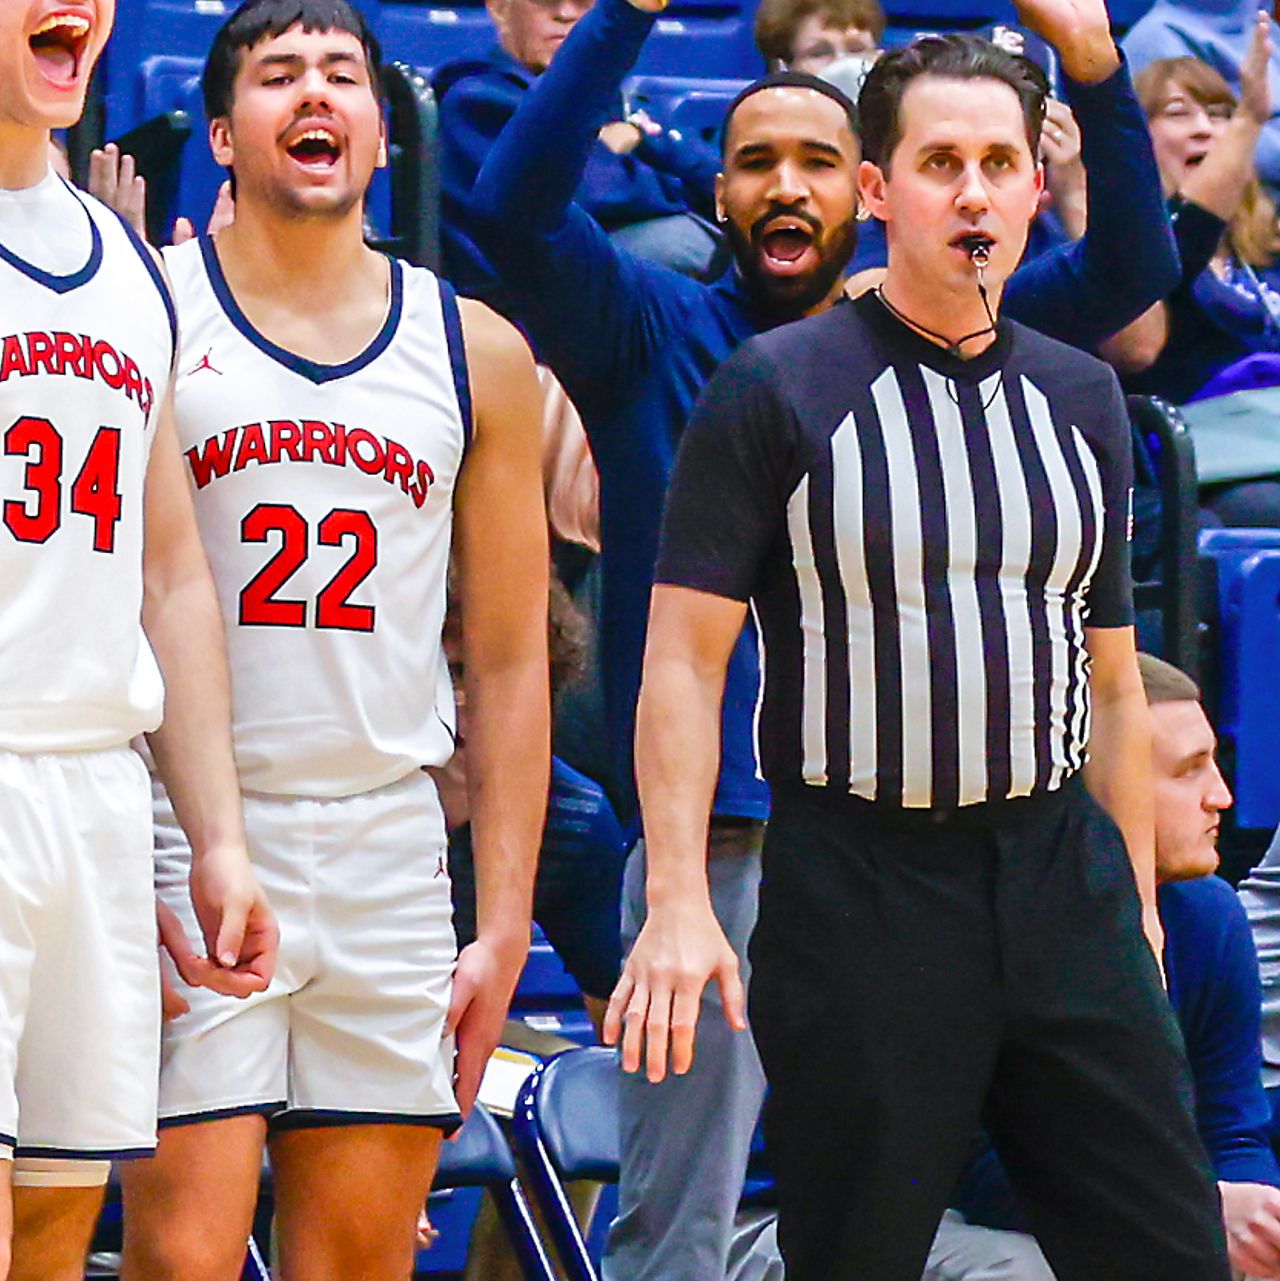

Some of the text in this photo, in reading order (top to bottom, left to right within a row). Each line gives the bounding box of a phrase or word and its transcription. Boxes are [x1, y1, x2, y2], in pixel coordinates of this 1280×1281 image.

[3, 415, 122, 554] 34
[184, 419, 436, 509] WARRIORS
[238, 503, 378, 633] 22
